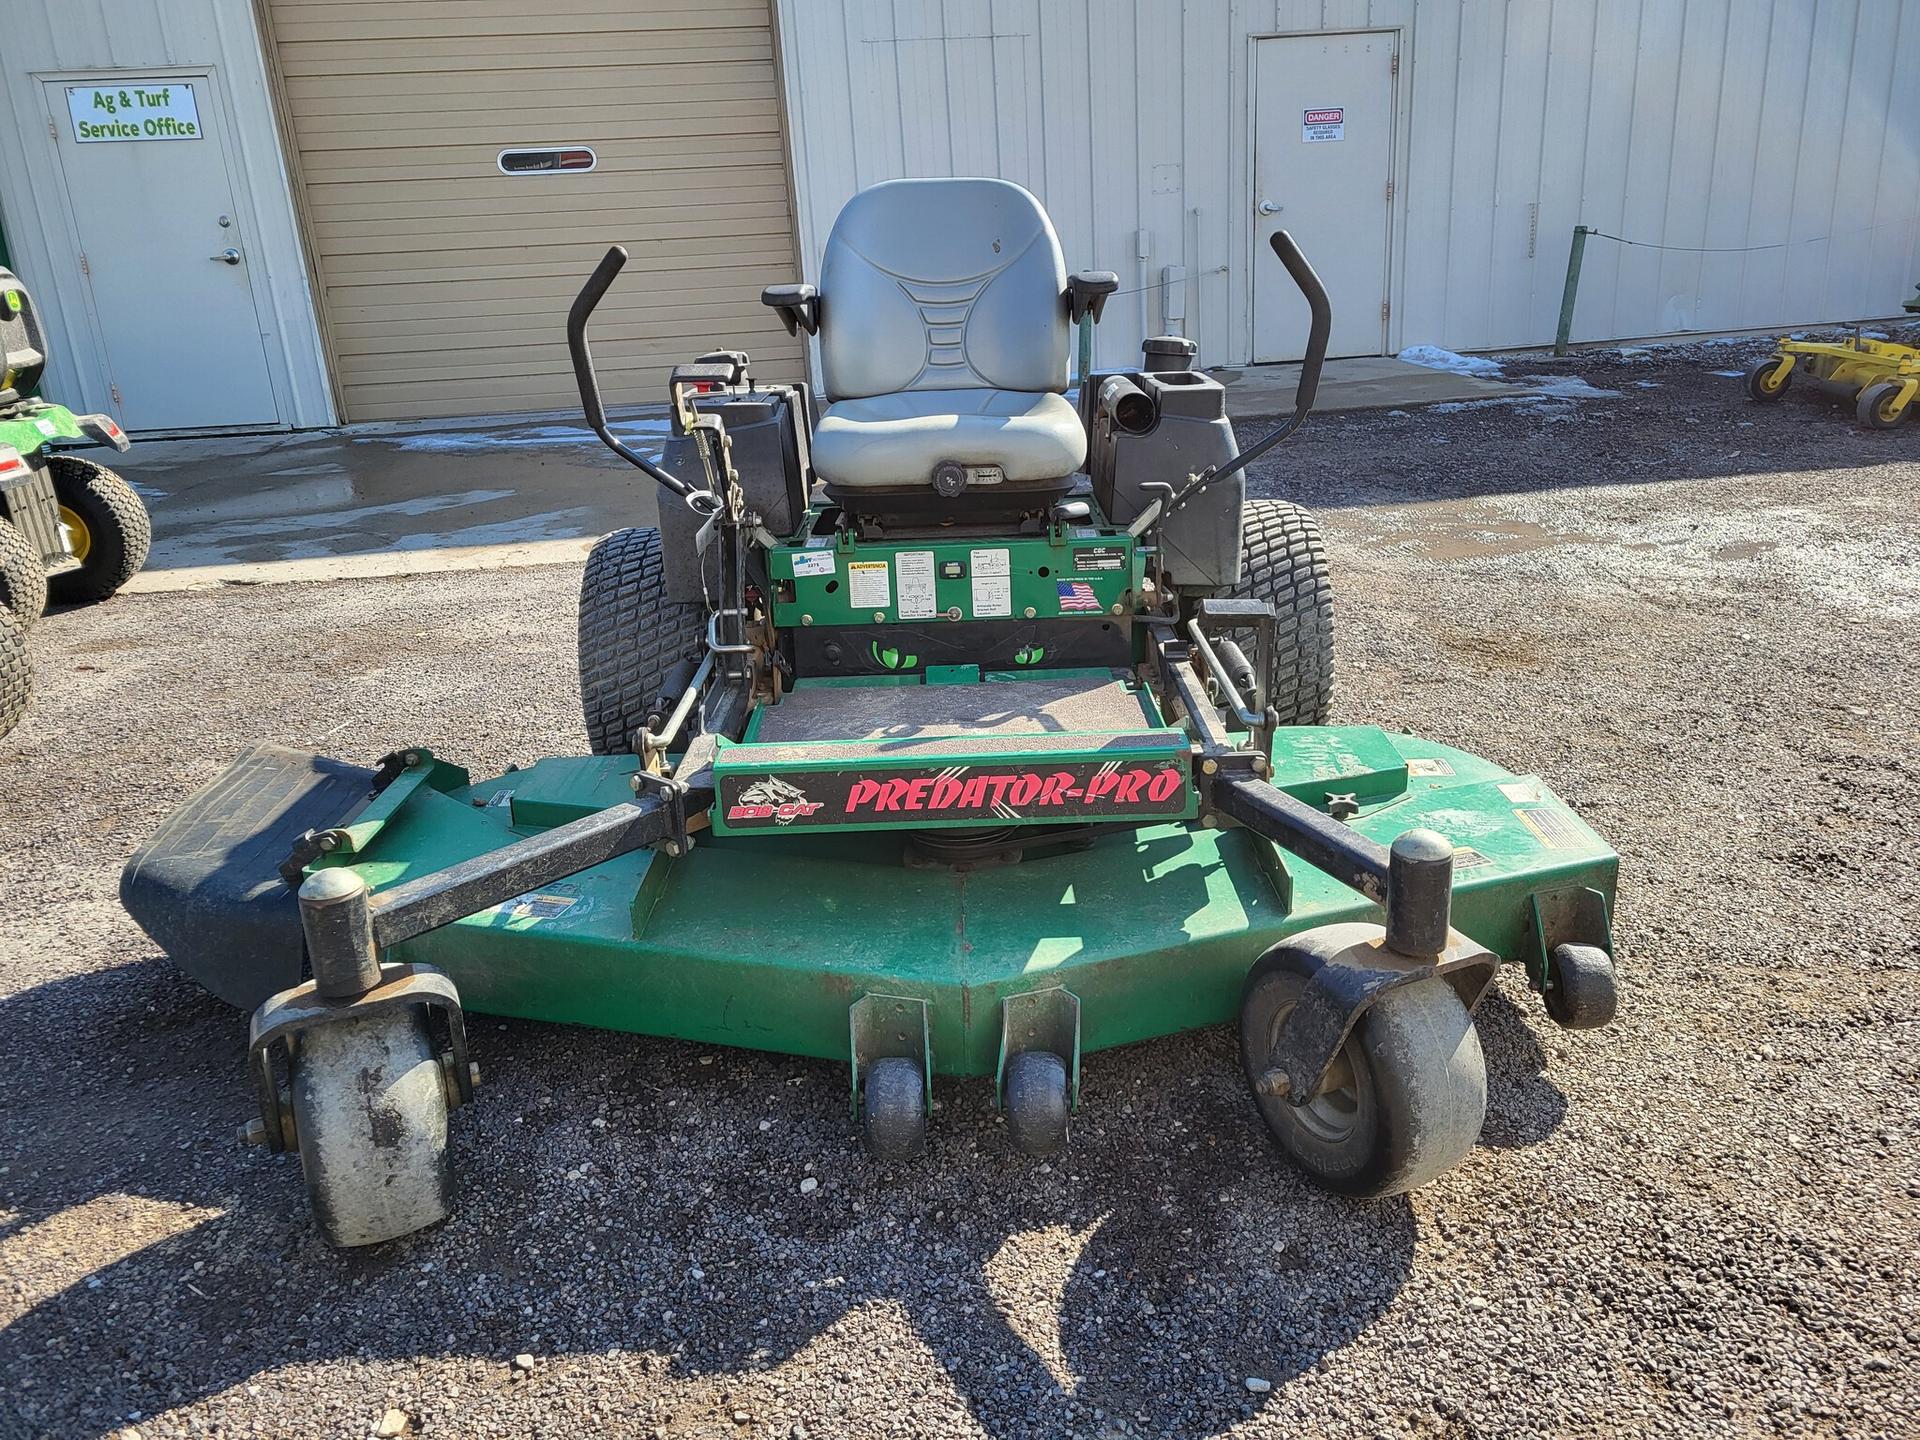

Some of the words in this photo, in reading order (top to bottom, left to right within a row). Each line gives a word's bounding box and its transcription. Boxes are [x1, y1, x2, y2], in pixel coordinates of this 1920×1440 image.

[93, 91, 116, 114] Ag
[118, 90, 132, 108] &
[134, 88, 170, 107] Turf
[79, 119, 140, 138] Service
[143, 117, 196, 136] Office
[1308, 113, 1339, 121] DANGER
[845, 768, 1183, 813] PREDATOR-PRO
[728, 803, 821, 819] BOB-CAT
